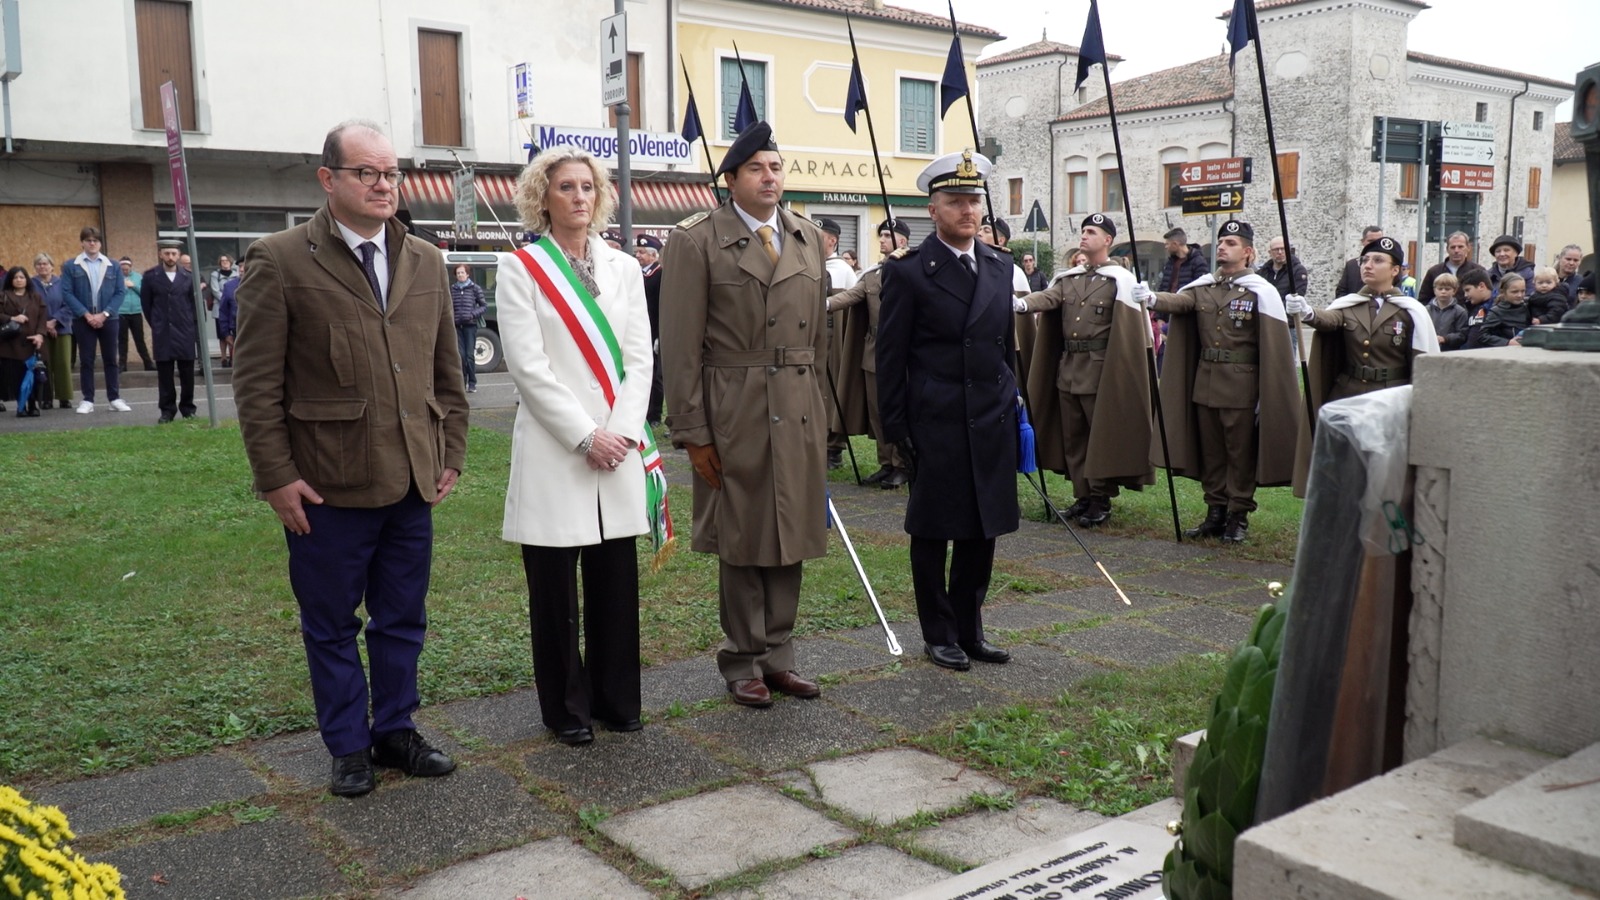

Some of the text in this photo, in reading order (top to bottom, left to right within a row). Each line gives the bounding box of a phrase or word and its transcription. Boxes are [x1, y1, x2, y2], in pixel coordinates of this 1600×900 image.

[605, 86, 625, 101] CODROIPO
[783, 159, 893, 178] ARMACIA
[823, 193, 868, 203] FARMACIA
[436, 231, 473, 240] TABACHI
